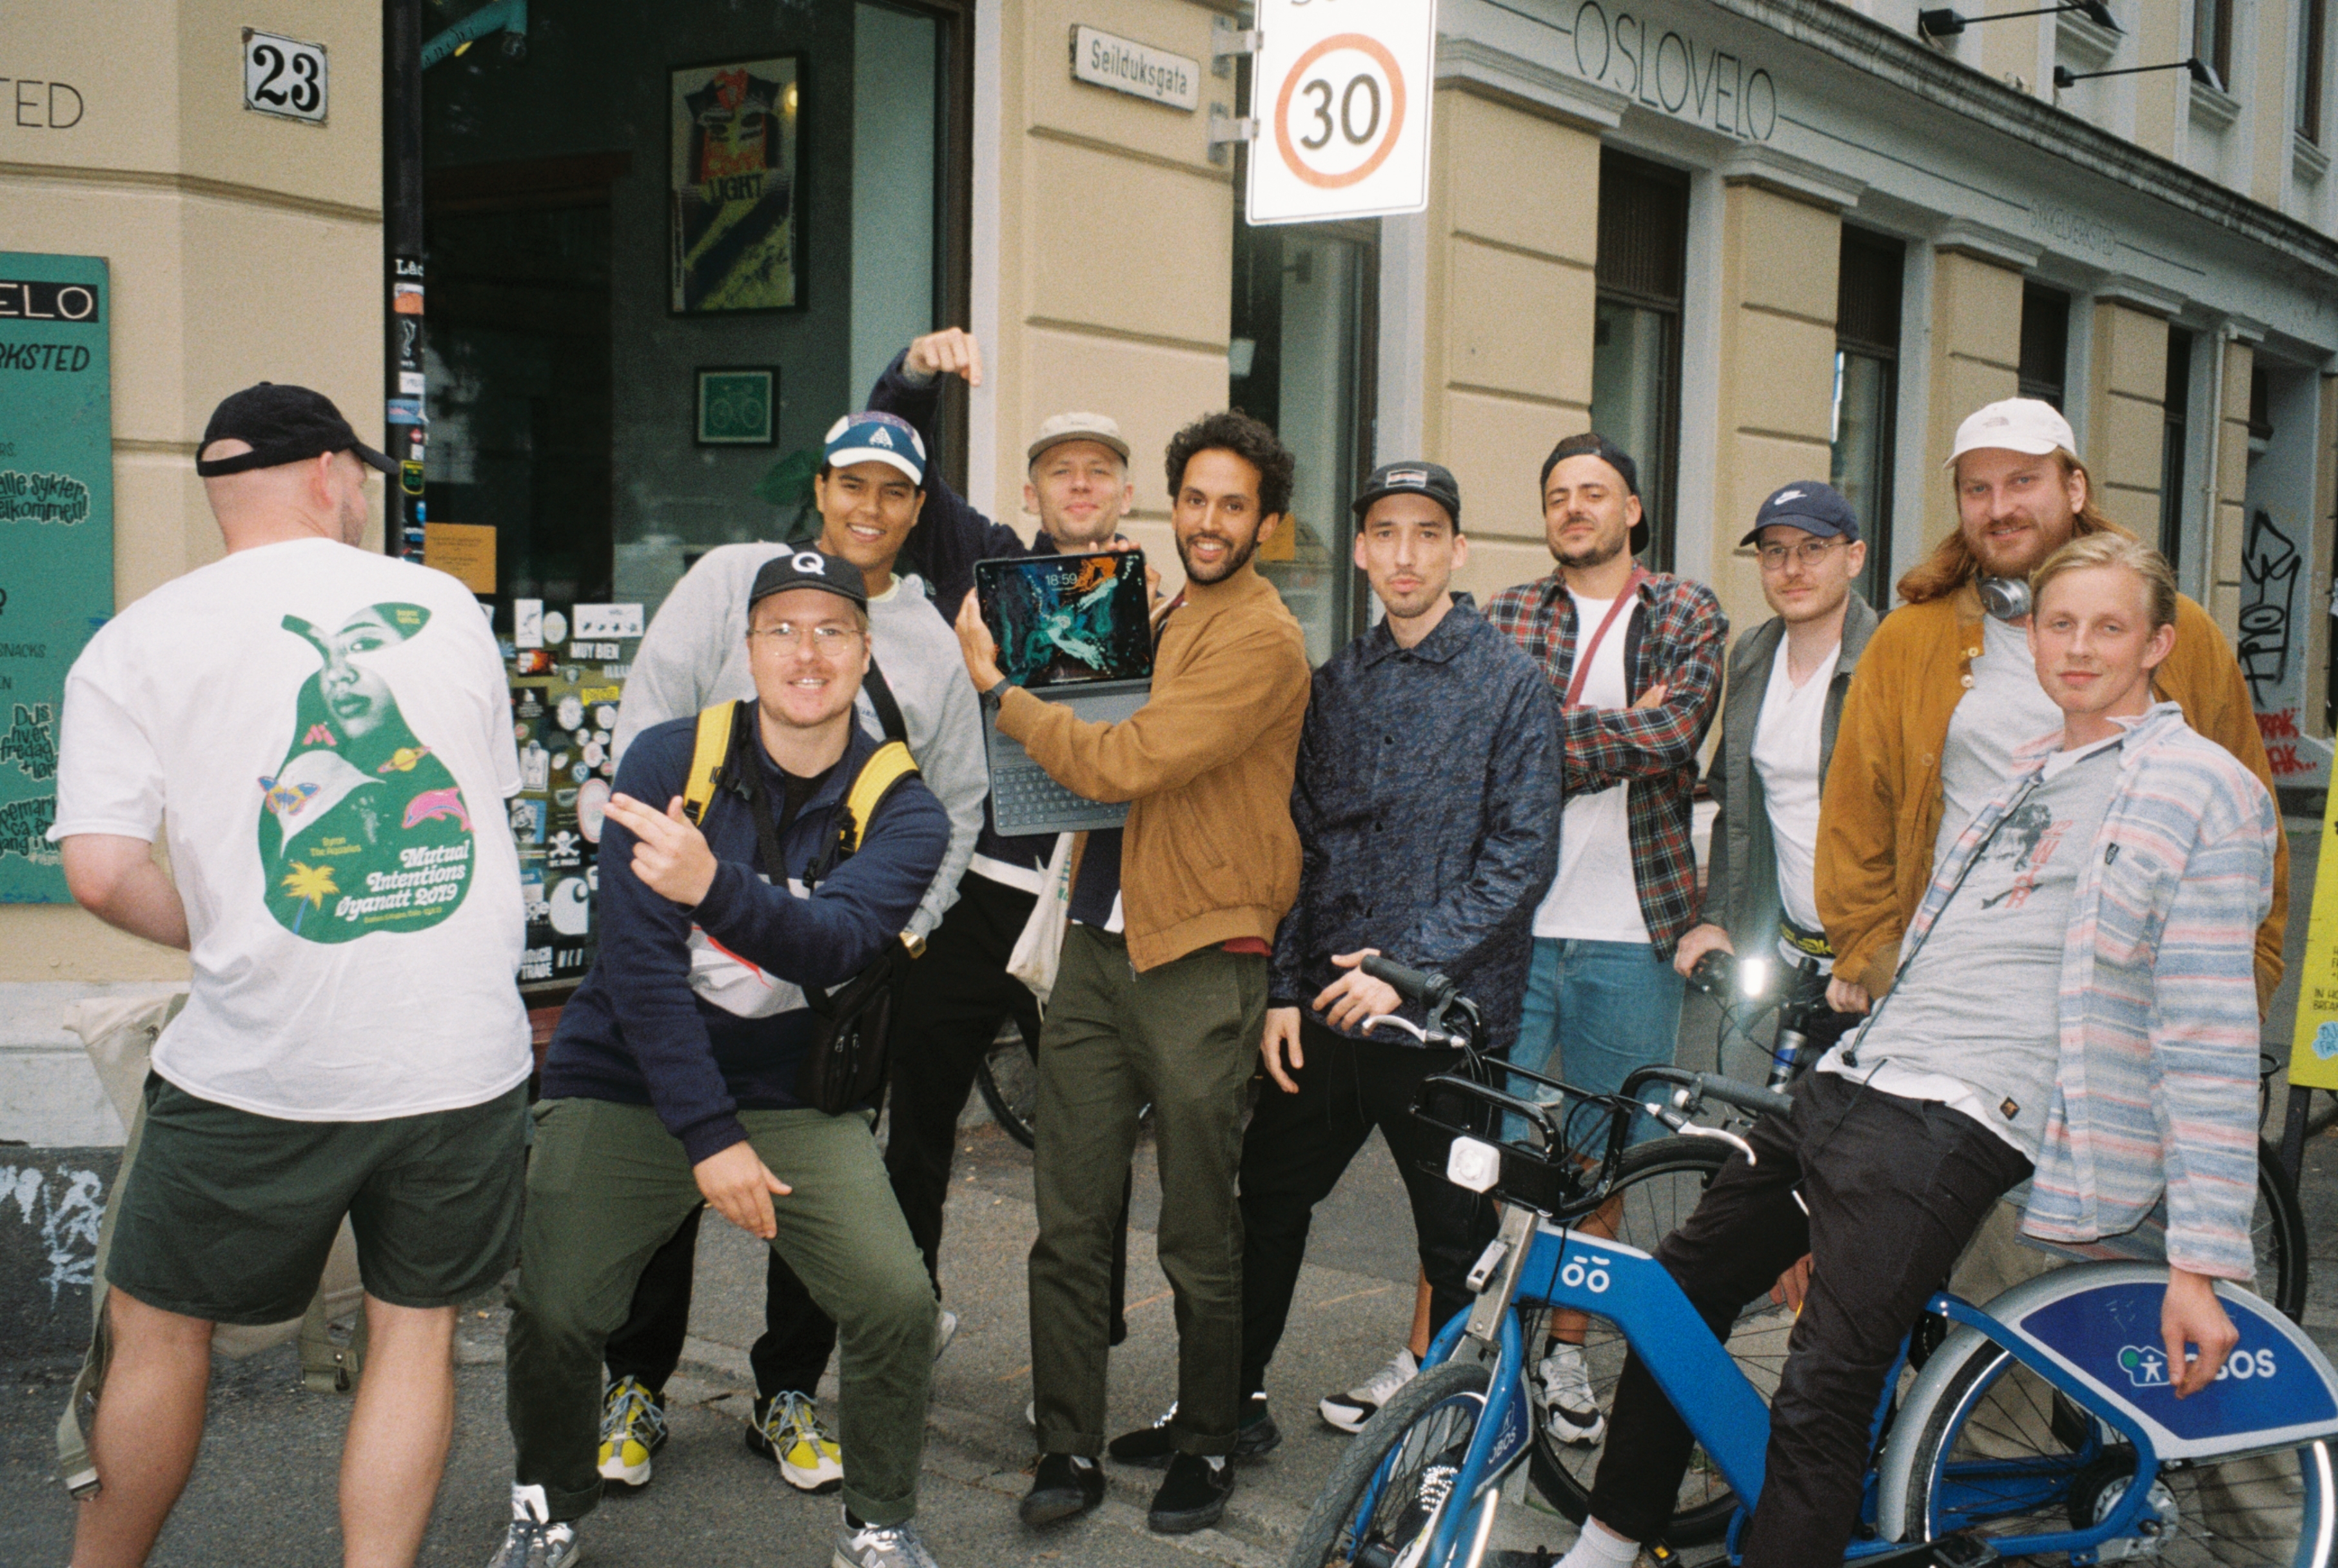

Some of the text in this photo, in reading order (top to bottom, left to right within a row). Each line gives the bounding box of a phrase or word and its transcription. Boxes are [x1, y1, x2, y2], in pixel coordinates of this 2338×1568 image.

[252, 44, 321, 113] 23
[1091, 39, 1188, 96] Seilduksgata
[1575, 0, 1777, 141] OSLOVELO
[1300, 73, 1381, 150] 30
[791, 551, 825, 576] Q
[1045, 573, 1078, 586] 18:59
[0, 736, 54, 763] fredag
[400, 839, 471, 868] Mutual
[366, 865, 466, 893] Intentions
[335, 888, 413, 922] Øyanatt
[415, 883, 458, 906] 2019
